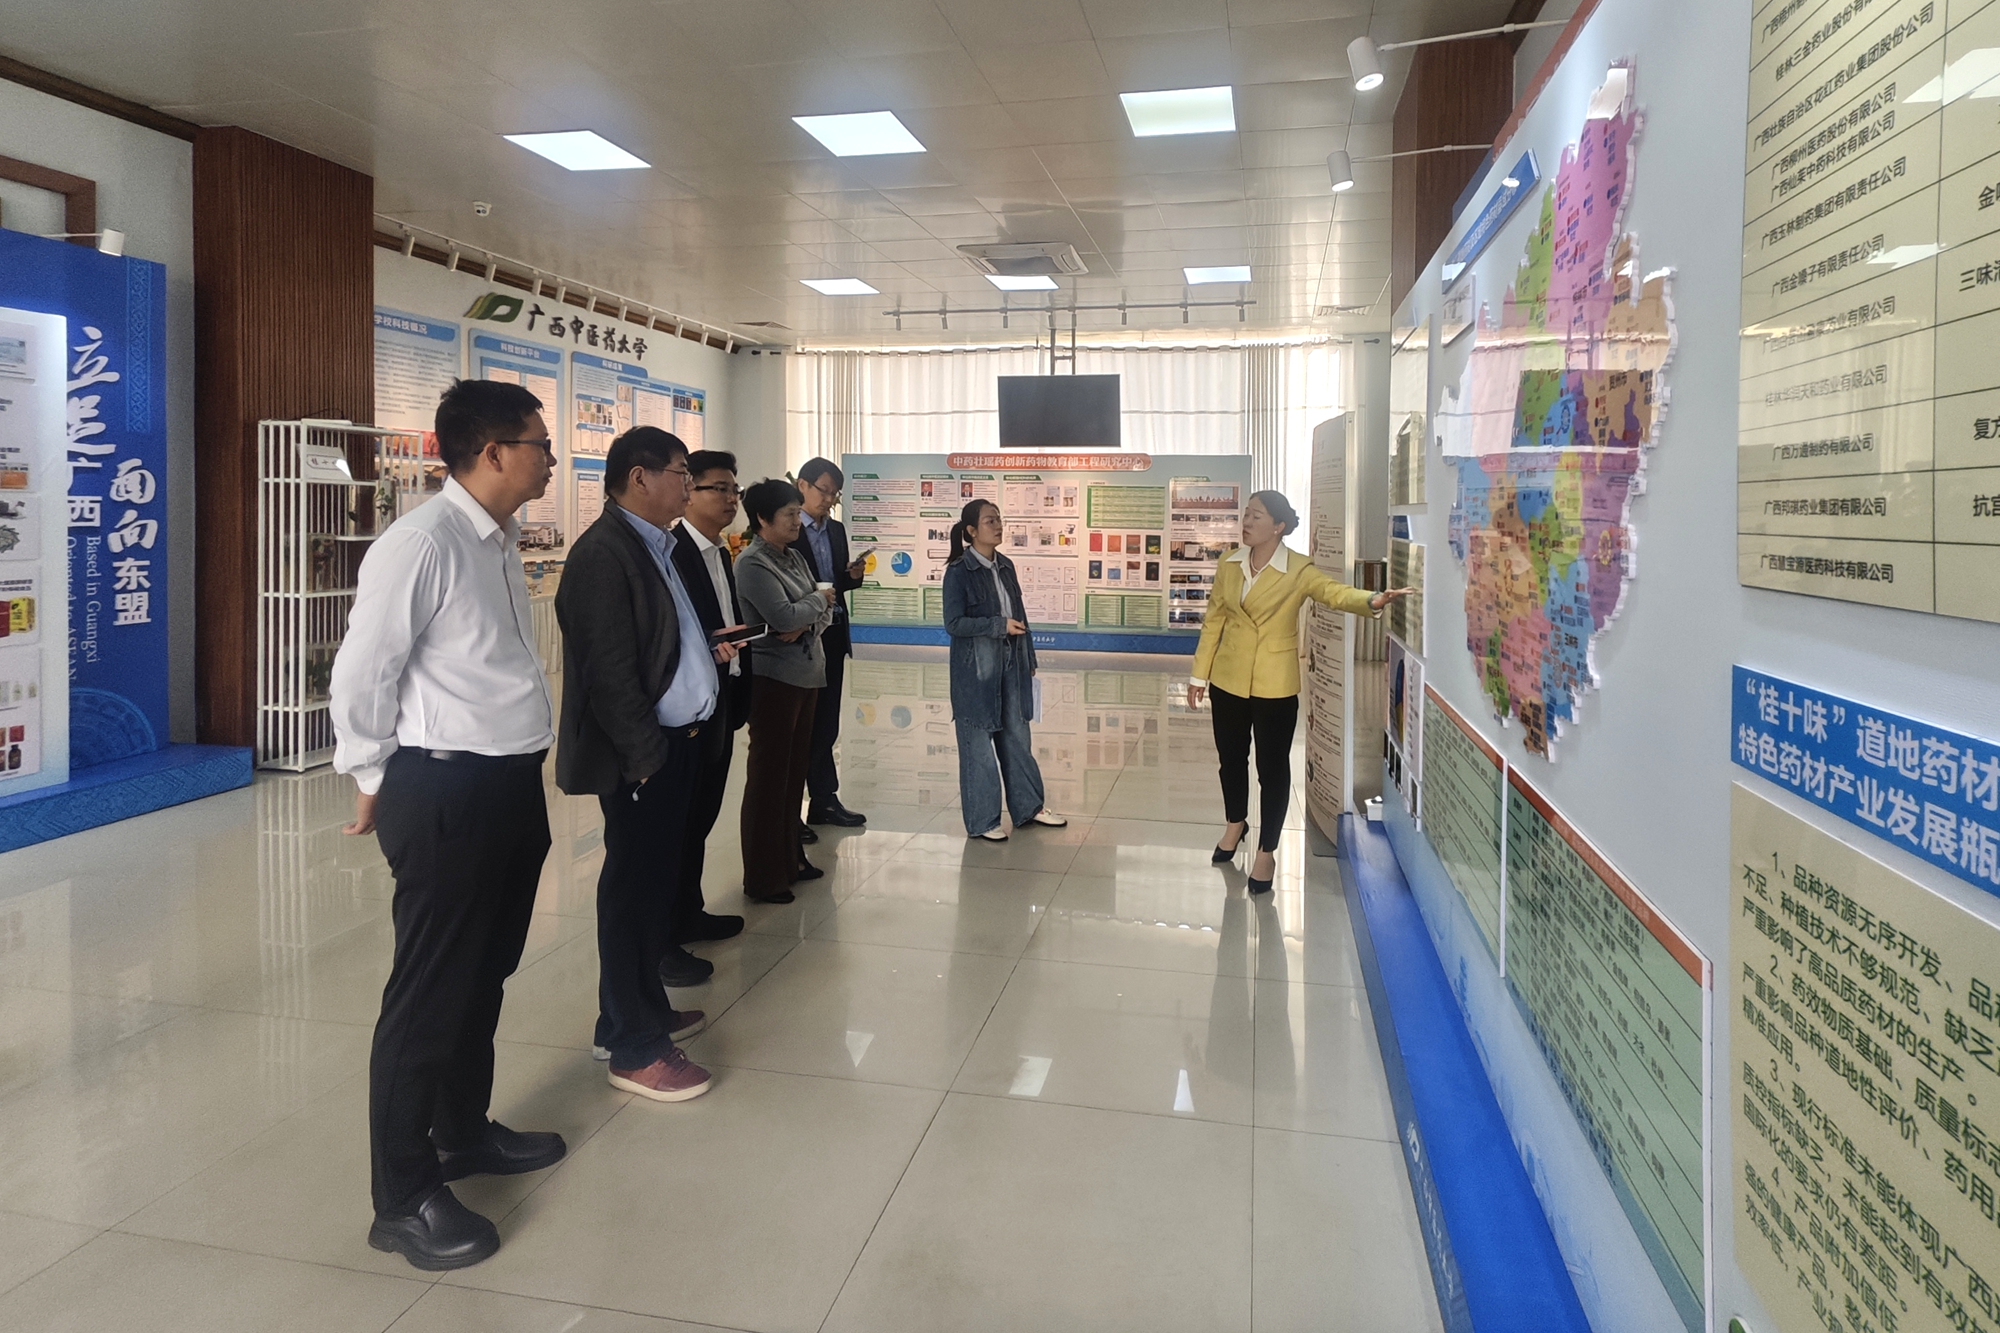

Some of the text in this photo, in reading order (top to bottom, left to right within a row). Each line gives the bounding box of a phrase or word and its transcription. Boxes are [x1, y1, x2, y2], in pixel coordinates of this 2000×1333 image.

[1753, 1, 1934, 152] 广西壮族自治区花红药业集团股份公司
[1771, 82, 1896, 181] 广西柳州医药股份有限公司
[1761, 156, 1907, 250] 广西玉林制药集团有限责任公司
[1771, 234, 1884, 298] 广西金嗓子有限责任公司
[527, 303, 648, 361] 广西中医药大学
[107, 458, 159, 626] 面向东盟
[1760, 554, 1894, 584] 广西慧宝源医药科技有限公司
[1764, 497, 1887, 517] 广西邦琪药业集团有限公司
[80, 536, 102, 663] Based in Guangxi
[1738, 723, 2000, 886] 特色药材产业发展瓶
[1743, 864, 2000, 1077] 不足、种植技术不够规范、缺乏
[1743, 896, 1977, 1106] 严重影响了高品质药材的生产。
[1771, 852, 2000, 1028] 1、品种资源无序开发、品
[1743, 961, 2000, 1229] 严重影响品种道地性评价、药用
